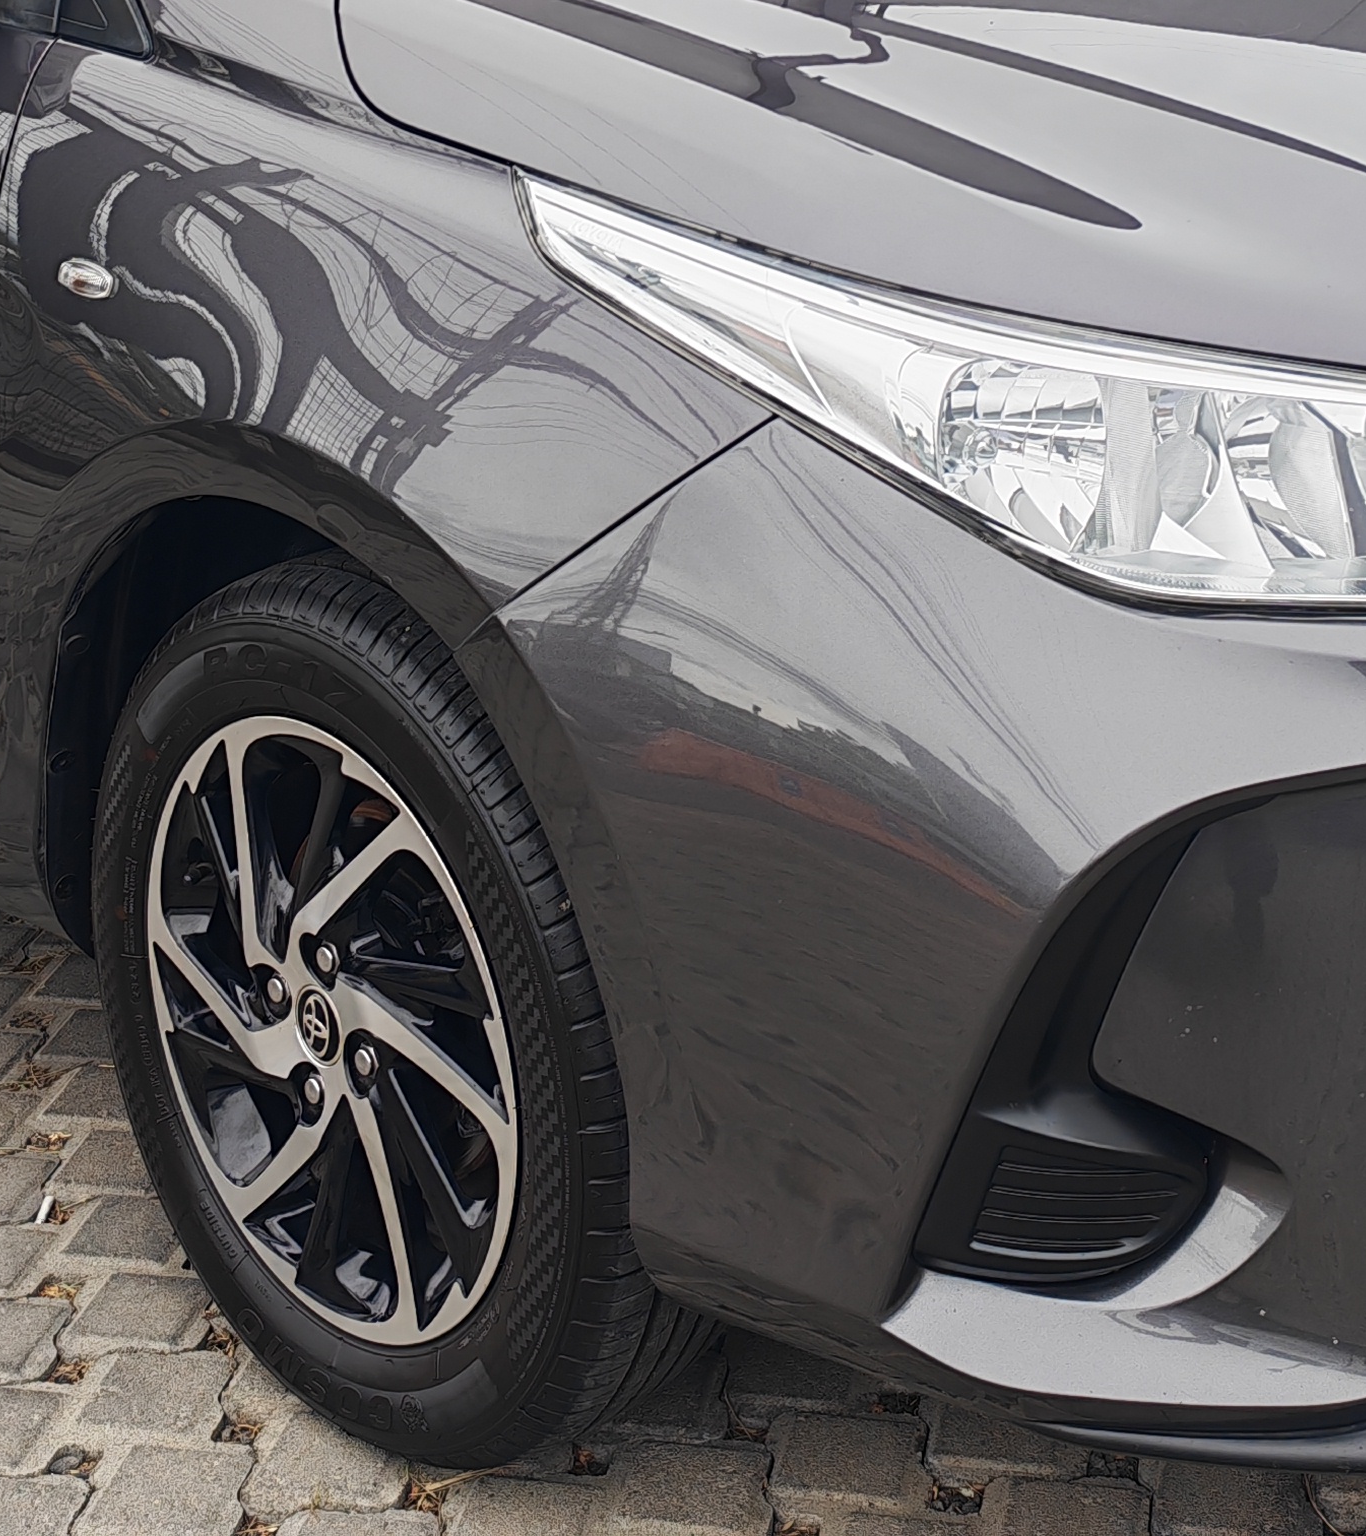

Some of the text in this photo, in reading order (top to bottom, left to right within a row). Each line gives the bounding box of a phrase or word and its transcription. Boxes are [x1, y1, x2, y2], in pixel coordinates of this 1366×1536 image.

[571, 219, 622, 249] TOYOTA
[199, 1200, 237, 1259] OUTSIDE
[236, 1307, 393, 1431] COSMO
